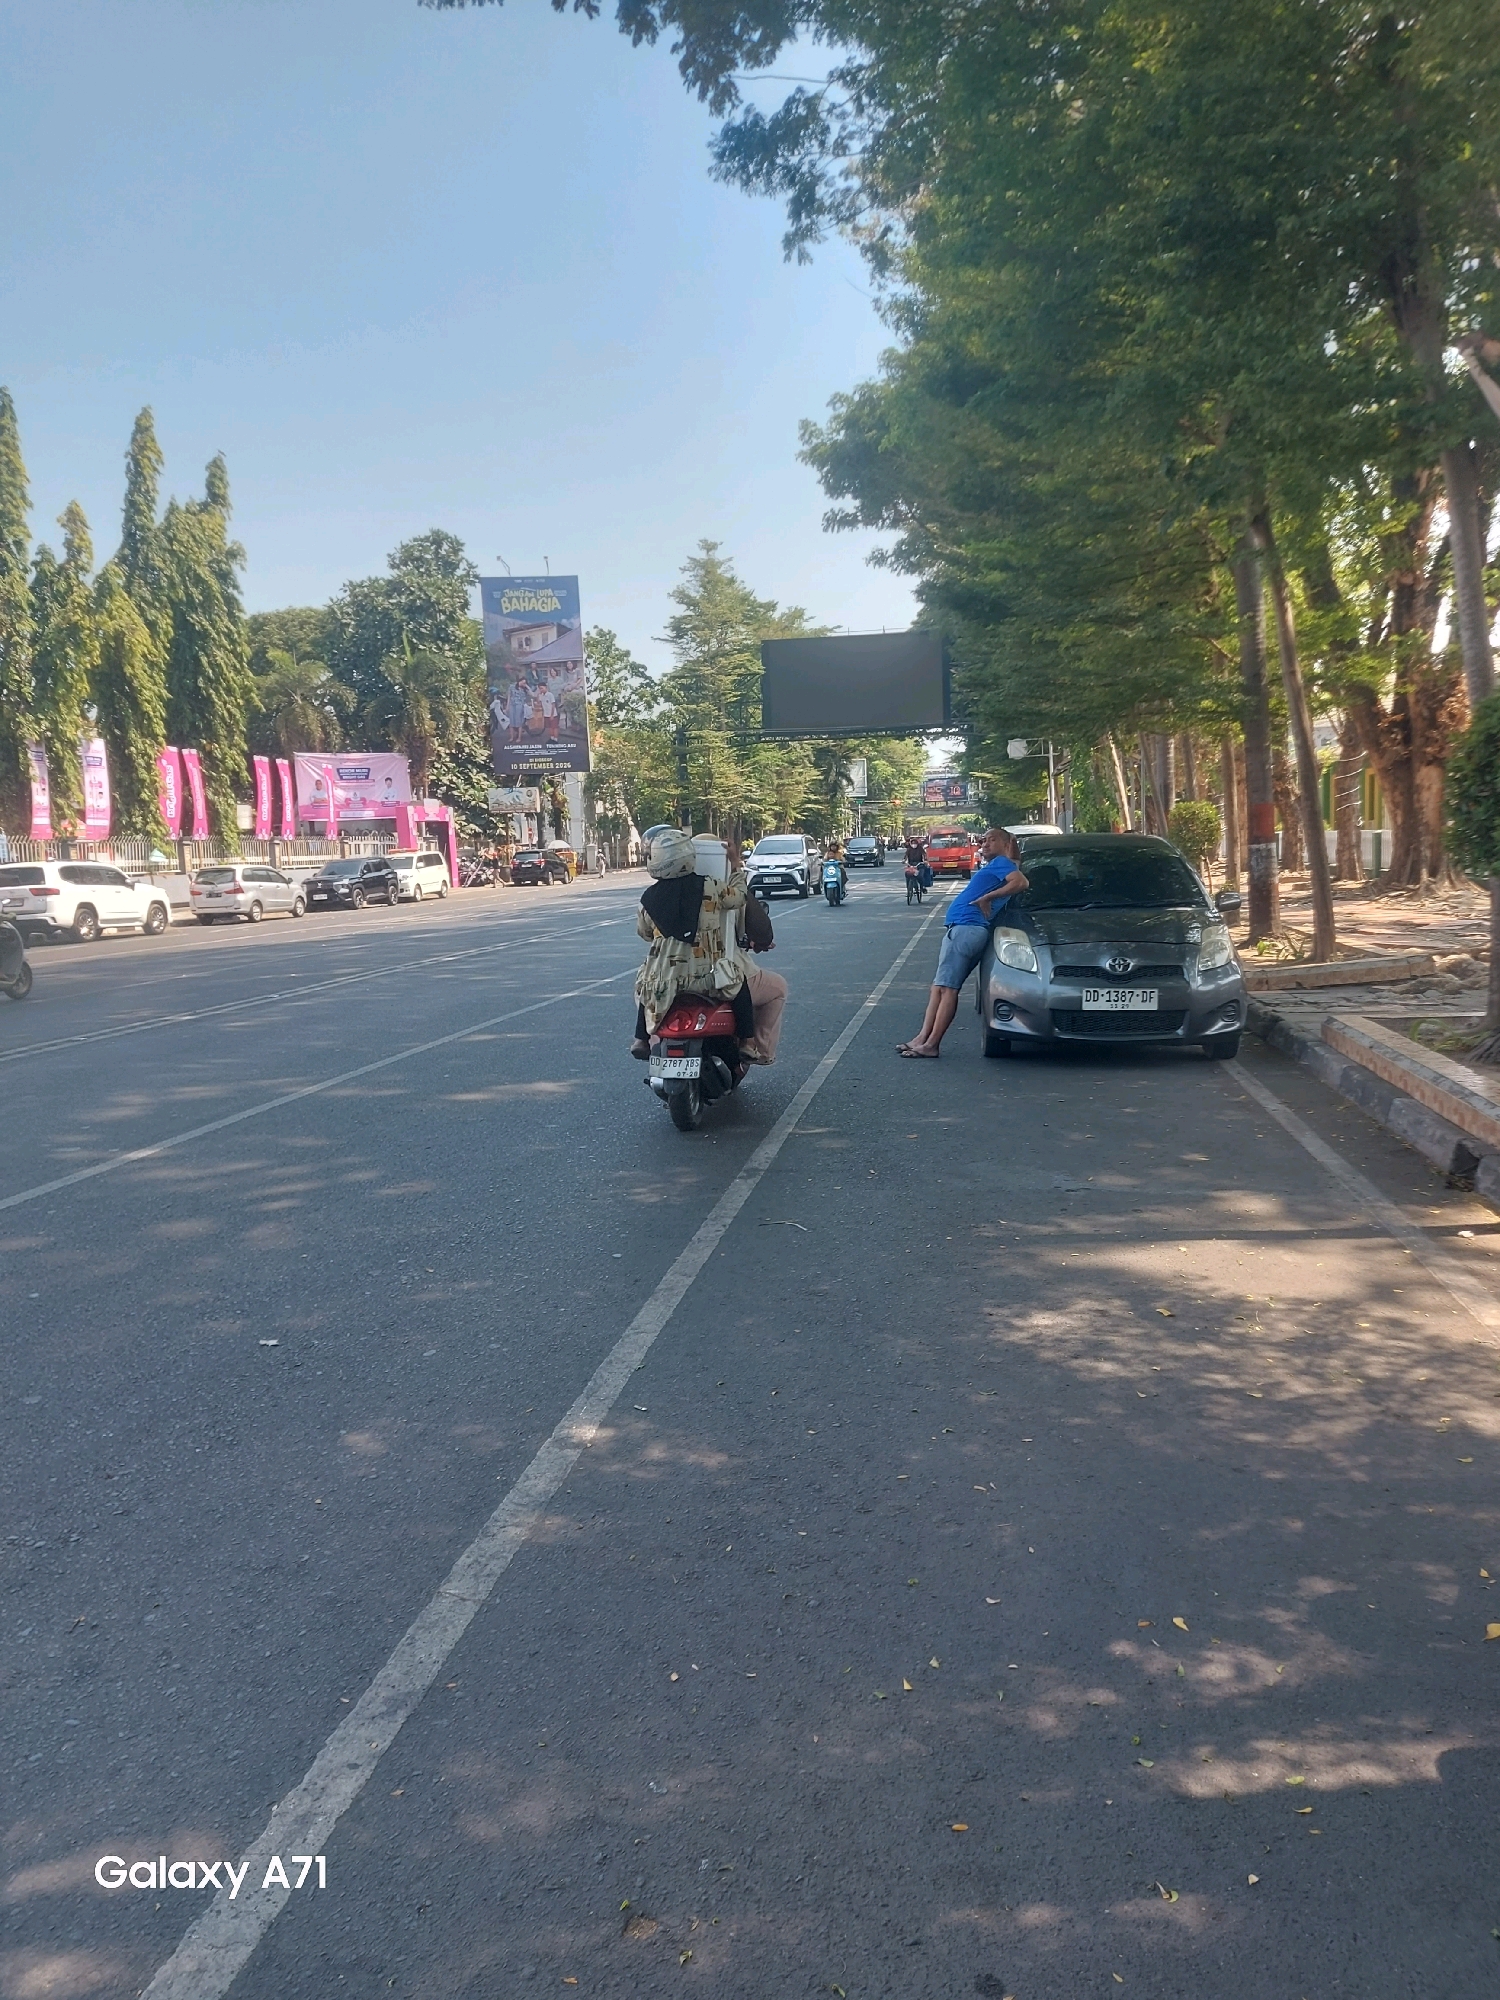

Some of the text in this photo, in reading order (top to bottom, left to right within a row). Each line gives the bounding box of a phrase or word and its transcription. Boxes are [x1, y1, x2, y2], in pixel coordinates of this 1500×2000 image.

[503, 588, 535, 598] JANGAN
[536, 588, 554, 599] LUPA
[501, 596, 561, 614] BAHAGIA
[519, 762, 554, 770] SEPTEMBER
[1084, 989, 1156, 1003] DD 1387 DF
[662, 1059, 682, 1067] 2787
